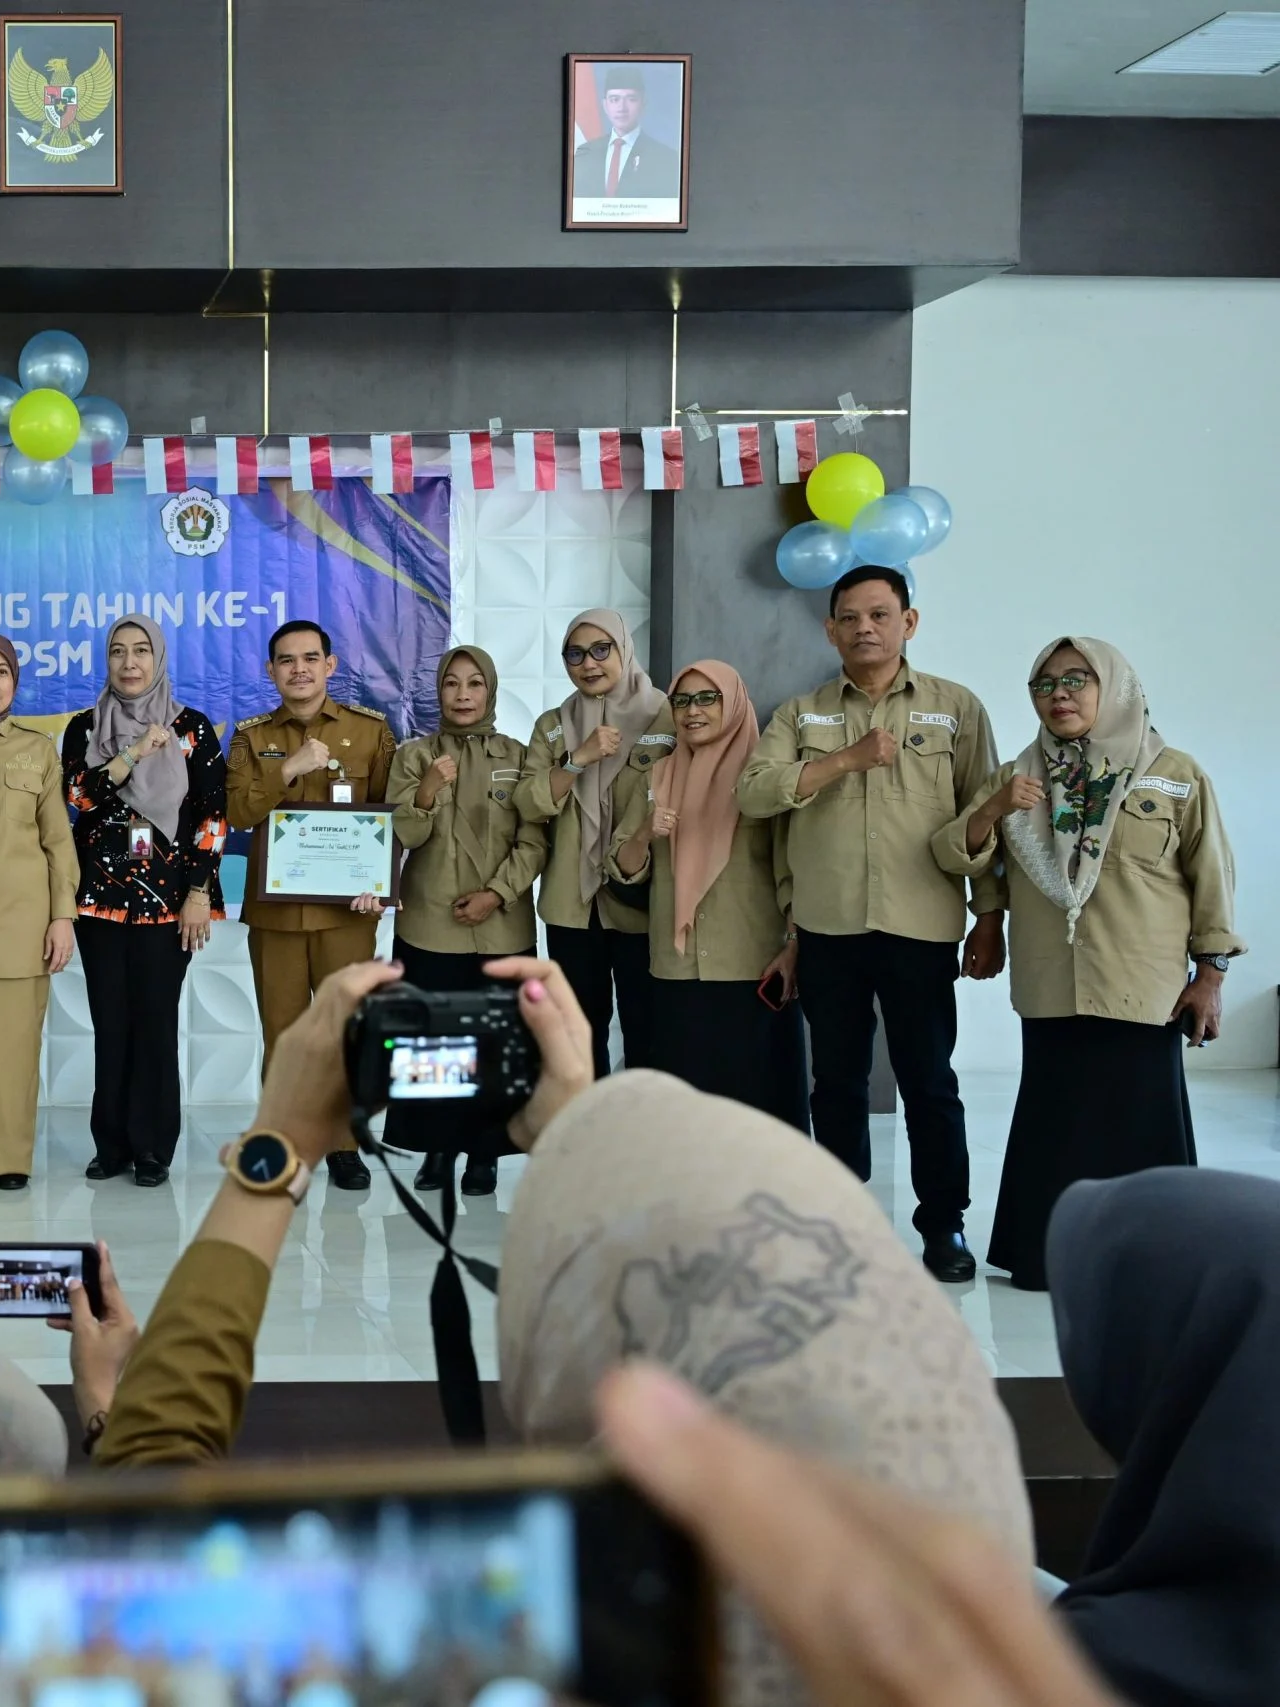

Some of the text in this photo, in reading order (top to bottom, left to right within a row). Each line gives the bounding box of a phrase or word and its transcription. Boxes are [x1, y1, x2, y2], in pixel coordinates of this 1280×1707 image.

[42, 592, 184, 628] TAHUN
[196, 591, 286, 627] KE-1
[921, 715, 951, 726] KETUA
